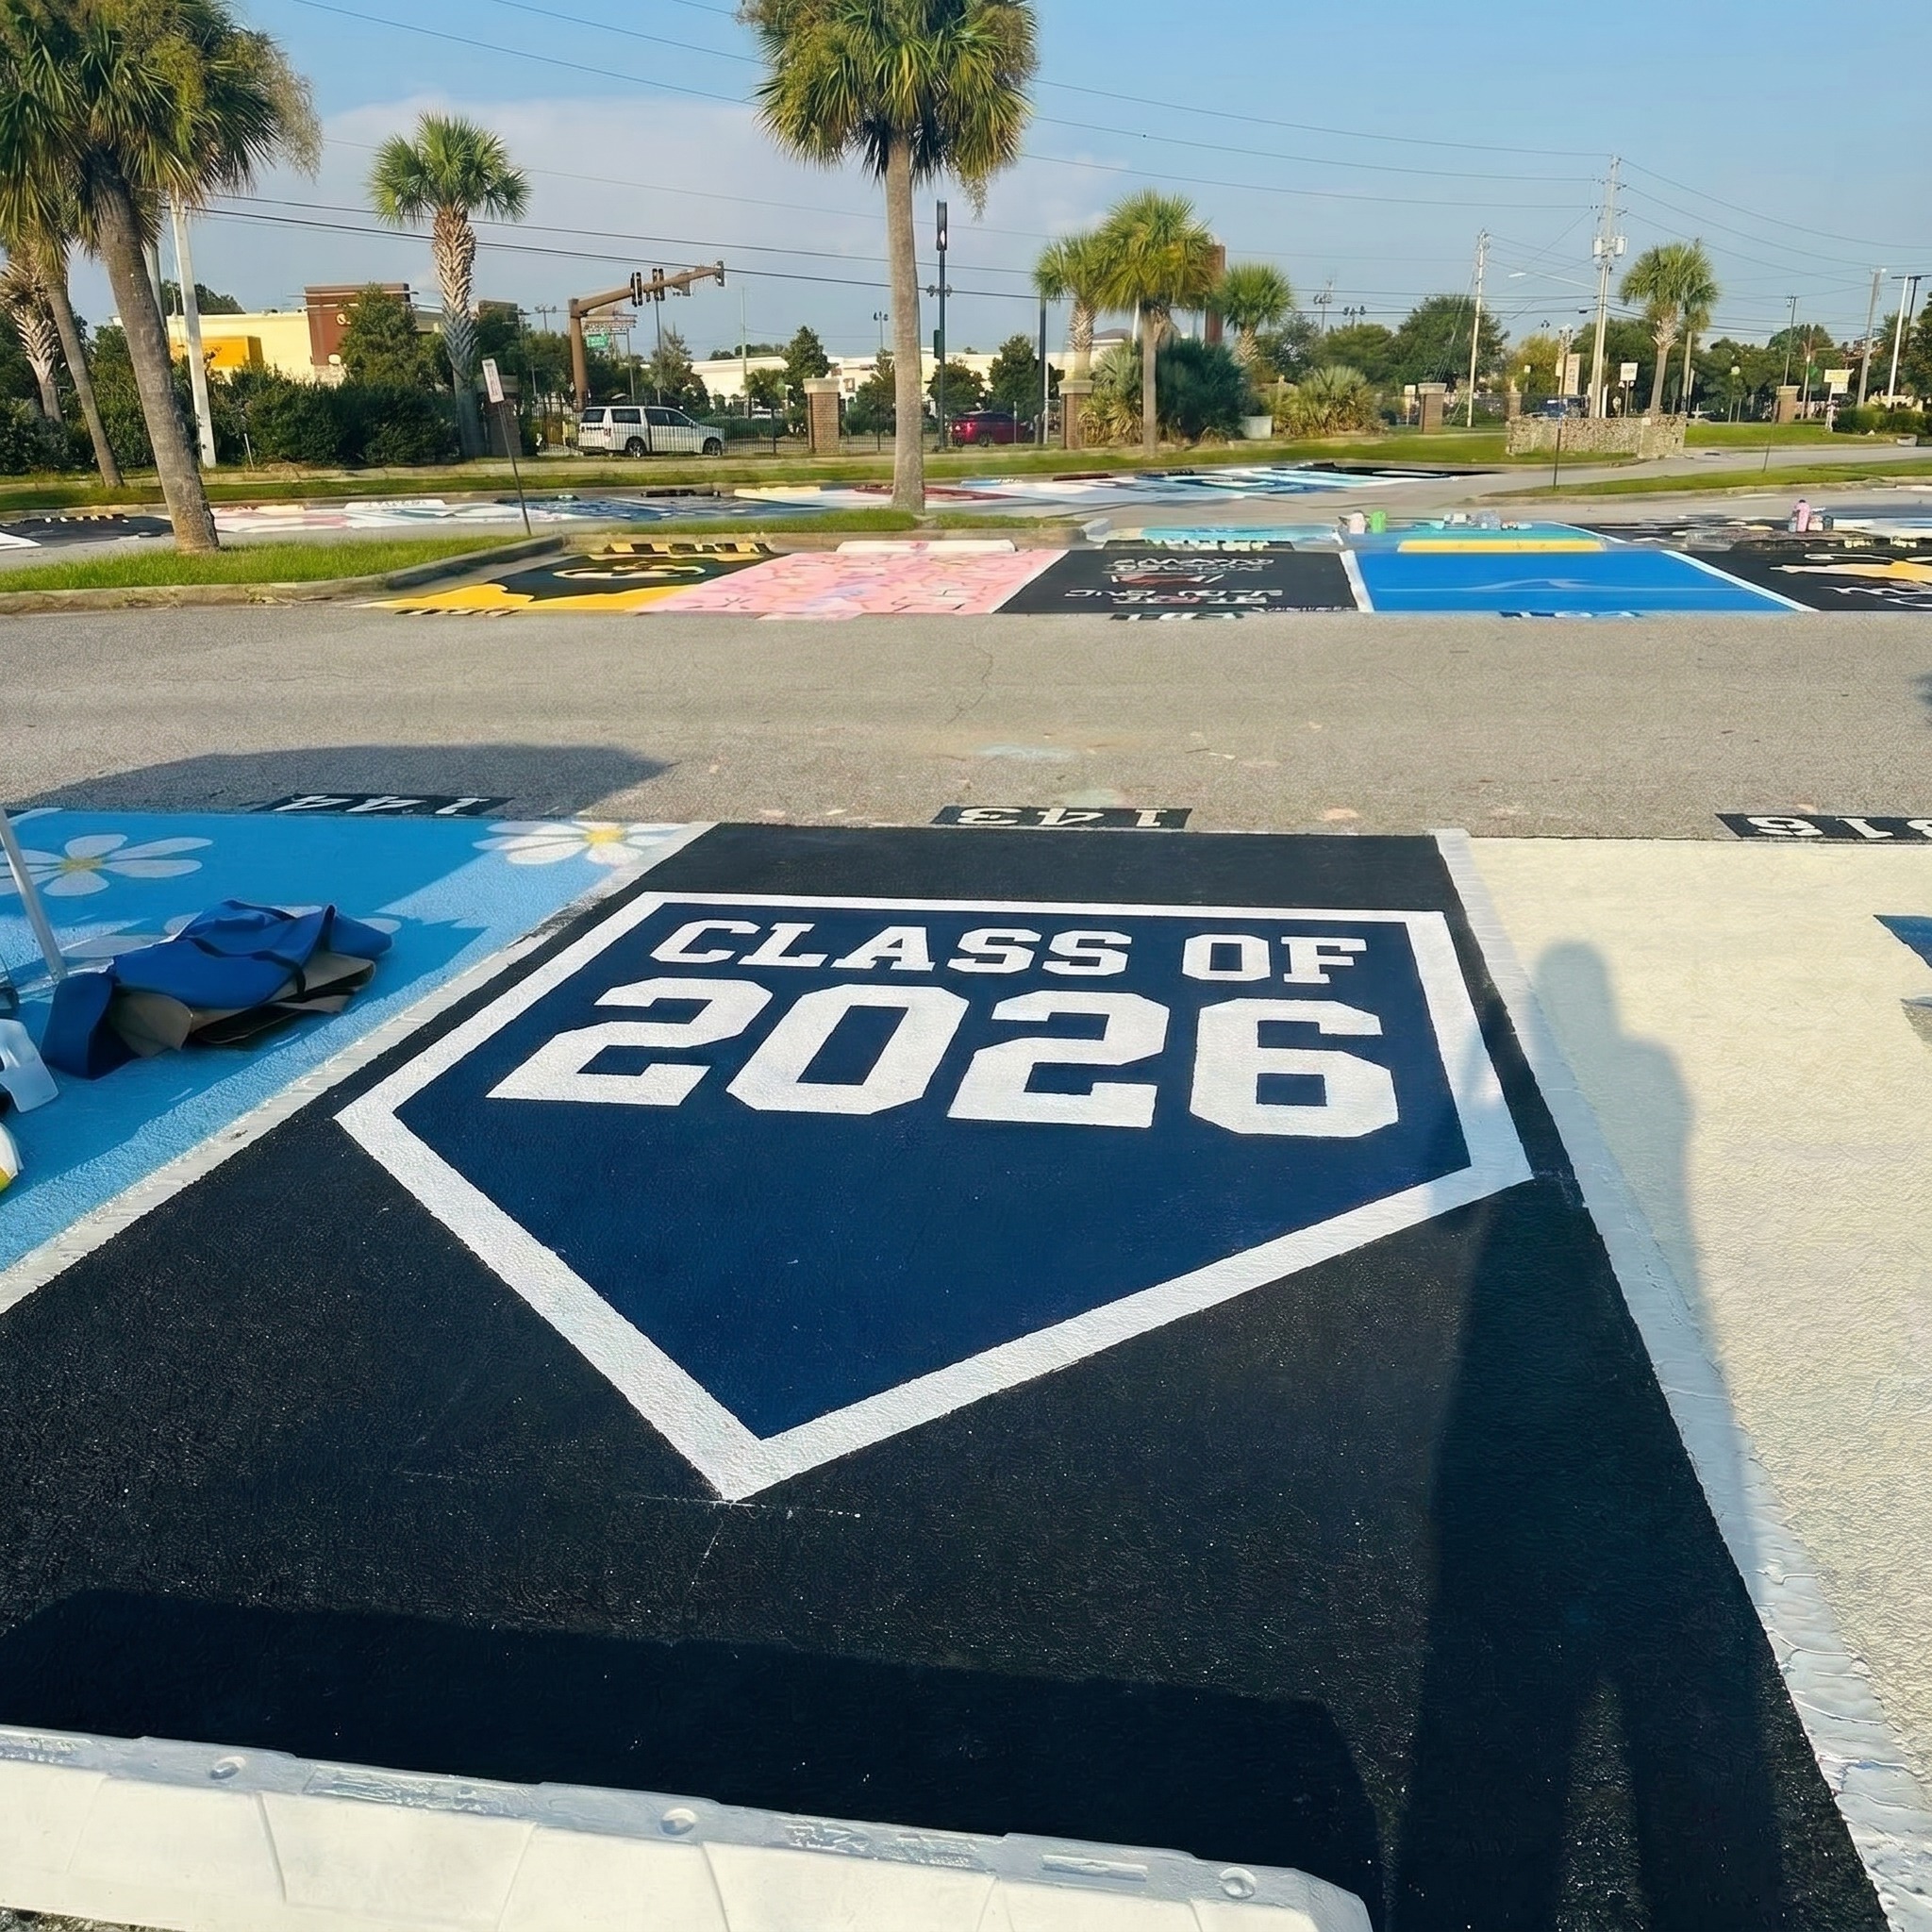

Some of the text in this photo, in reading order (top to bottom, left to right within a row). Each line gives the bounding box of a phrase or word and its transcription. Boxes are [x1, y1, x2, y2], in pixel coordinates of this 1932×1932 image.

[274, 794, 491, 815] 144
[957, 807, 1168, 827] 143
[649, 918, 1368, 984] CLASS OF
[485, 976, 1400, 1138] 2026
